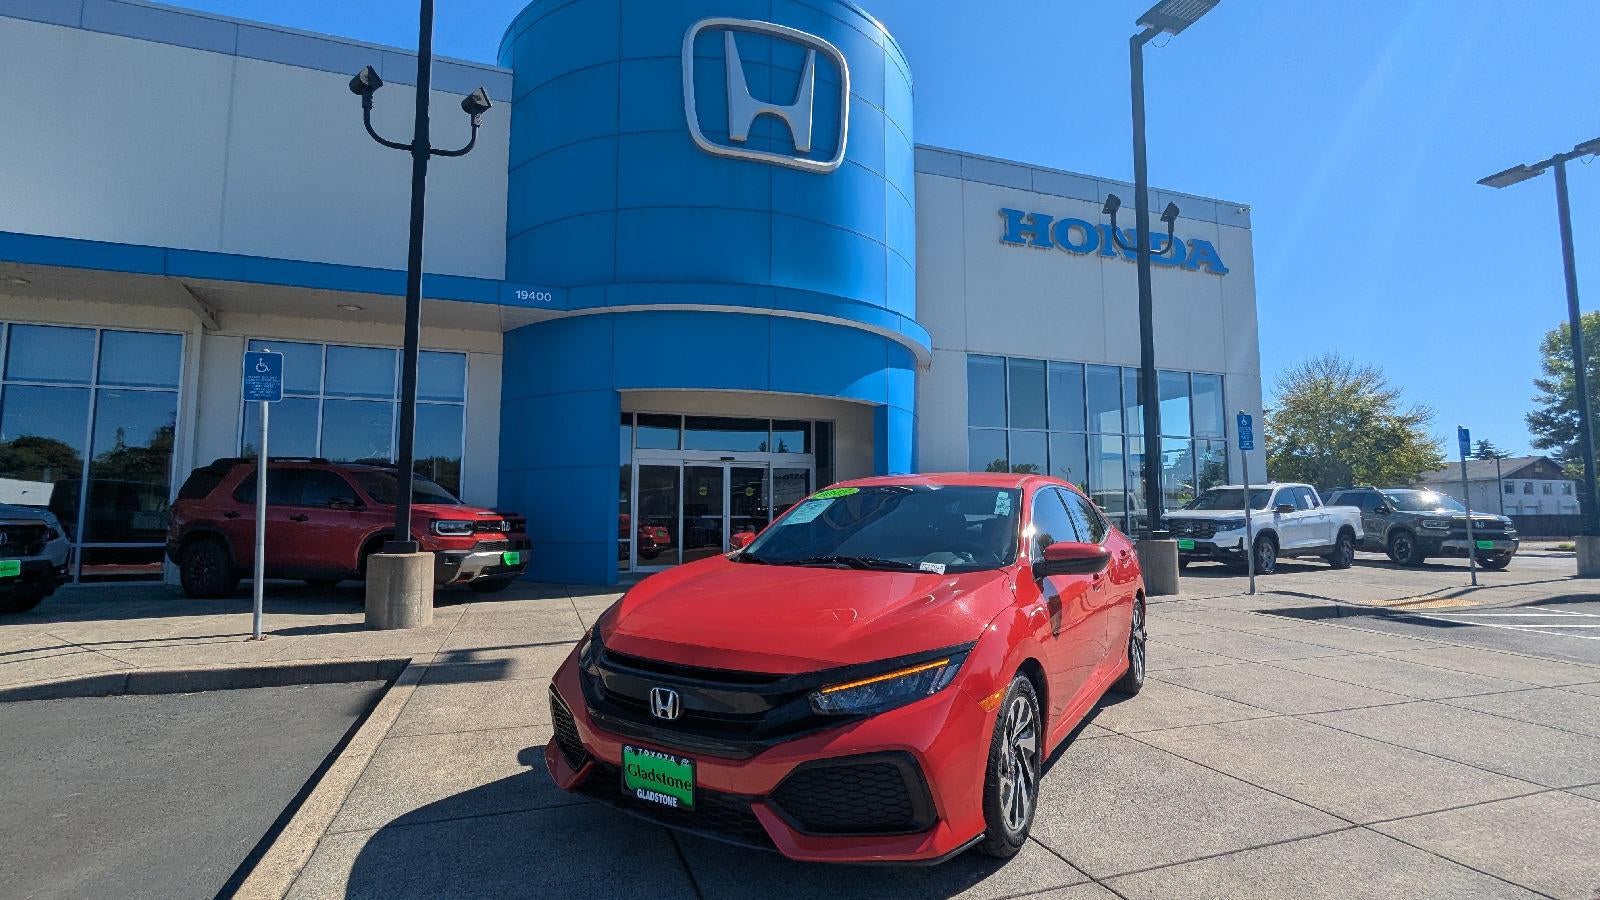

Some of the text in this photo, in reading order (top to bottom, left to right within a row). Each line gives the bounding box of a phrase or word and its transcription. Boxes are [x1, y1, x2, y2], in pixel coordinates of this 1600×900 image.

[999, 207, 1229, 275] HONDA
[515, 290, 551, 301] 19400
[638, 748, 675, 763] TOYOTA
[627, 763, 692, 791] Gladstone
[637, 788, 678, 807] GLADSTONE
